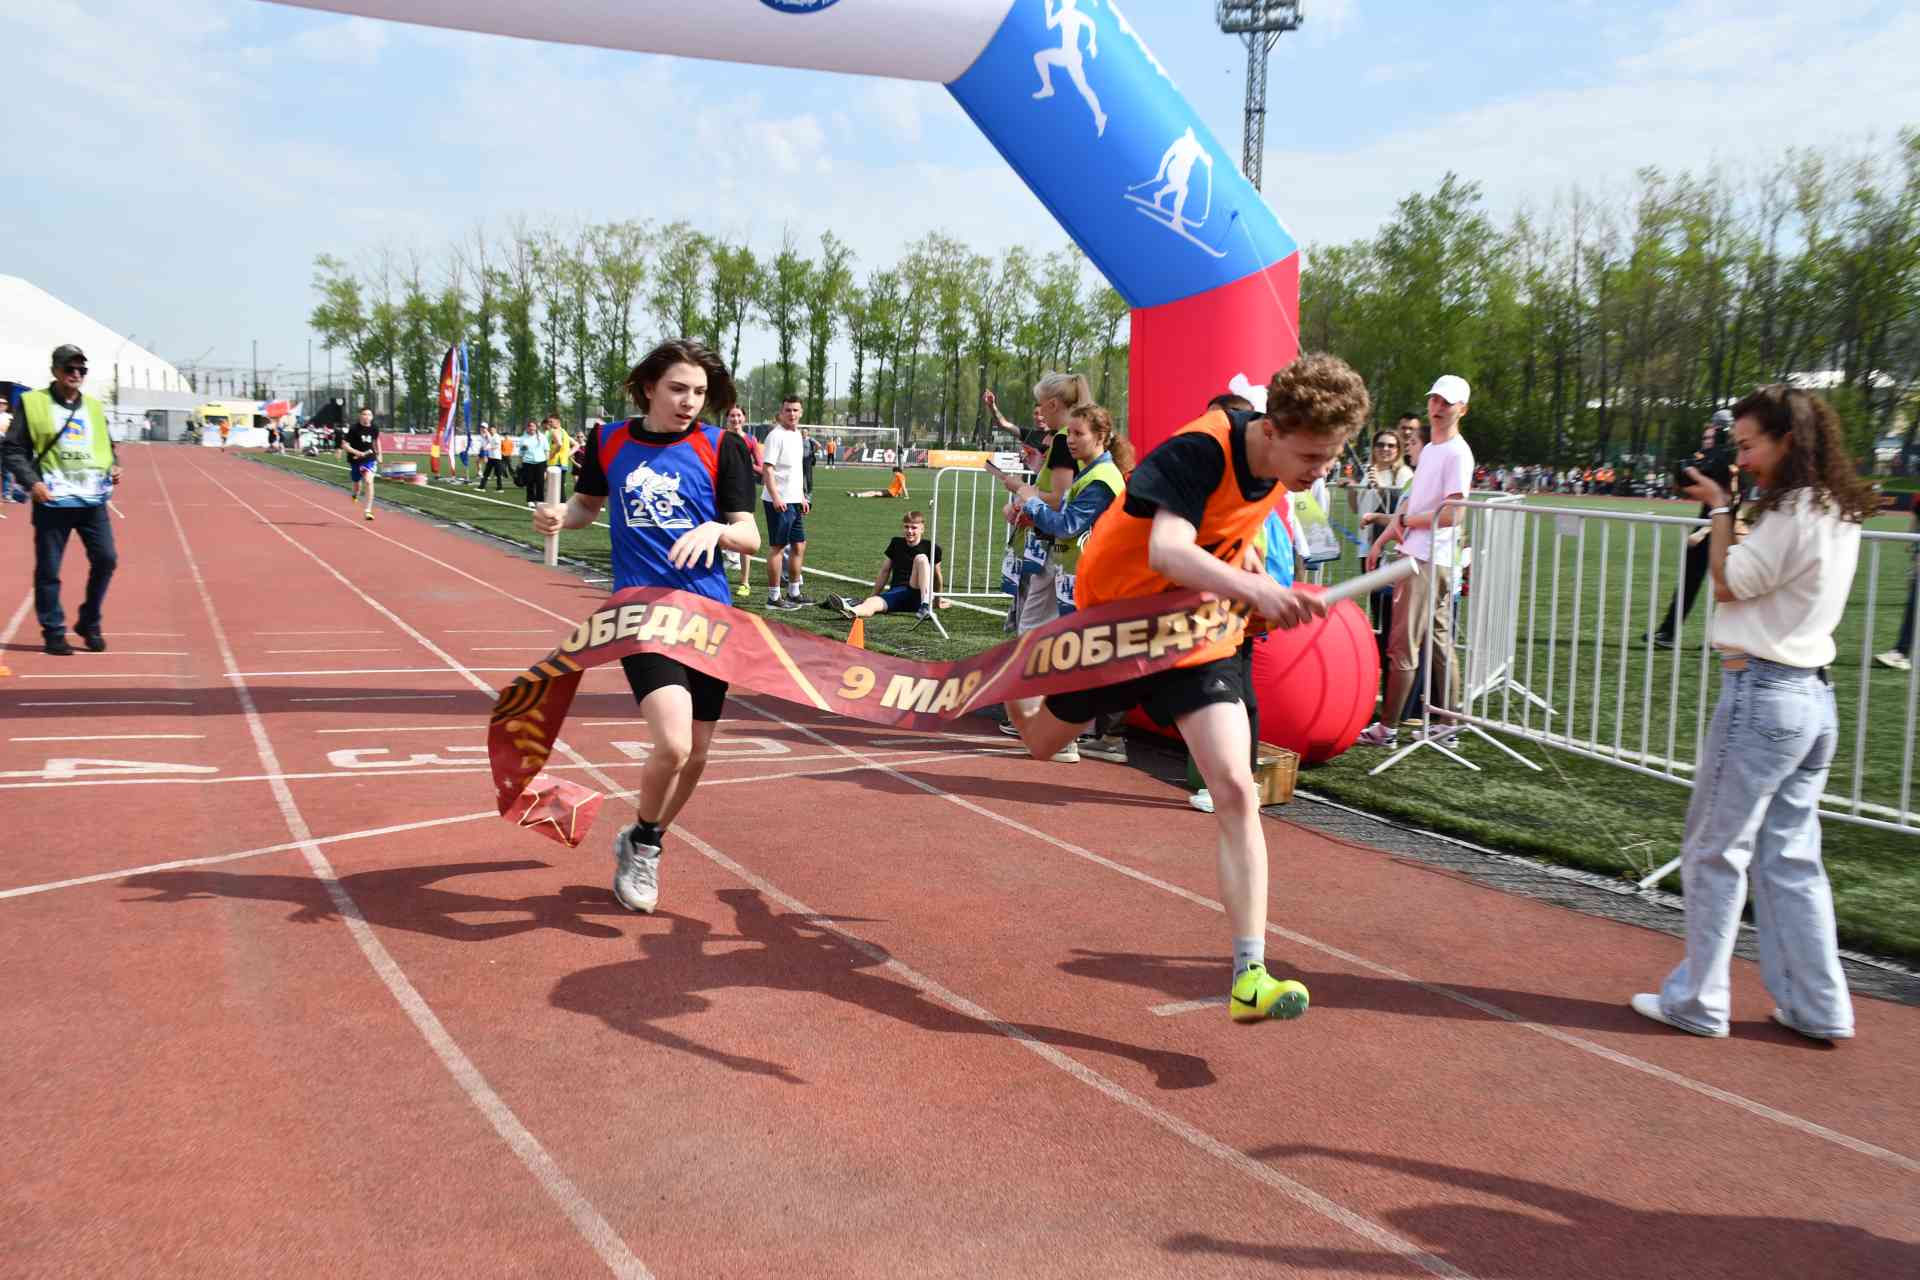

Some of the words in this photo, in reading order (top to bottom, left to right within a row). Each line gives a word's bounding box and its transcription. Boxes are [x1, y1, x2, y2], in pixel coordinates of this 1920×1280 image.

[560, 604, 729, 656] ОБЕДА!
[837, 665, 876, 700] 9
[880, 670, 982, 714] МАЯ
